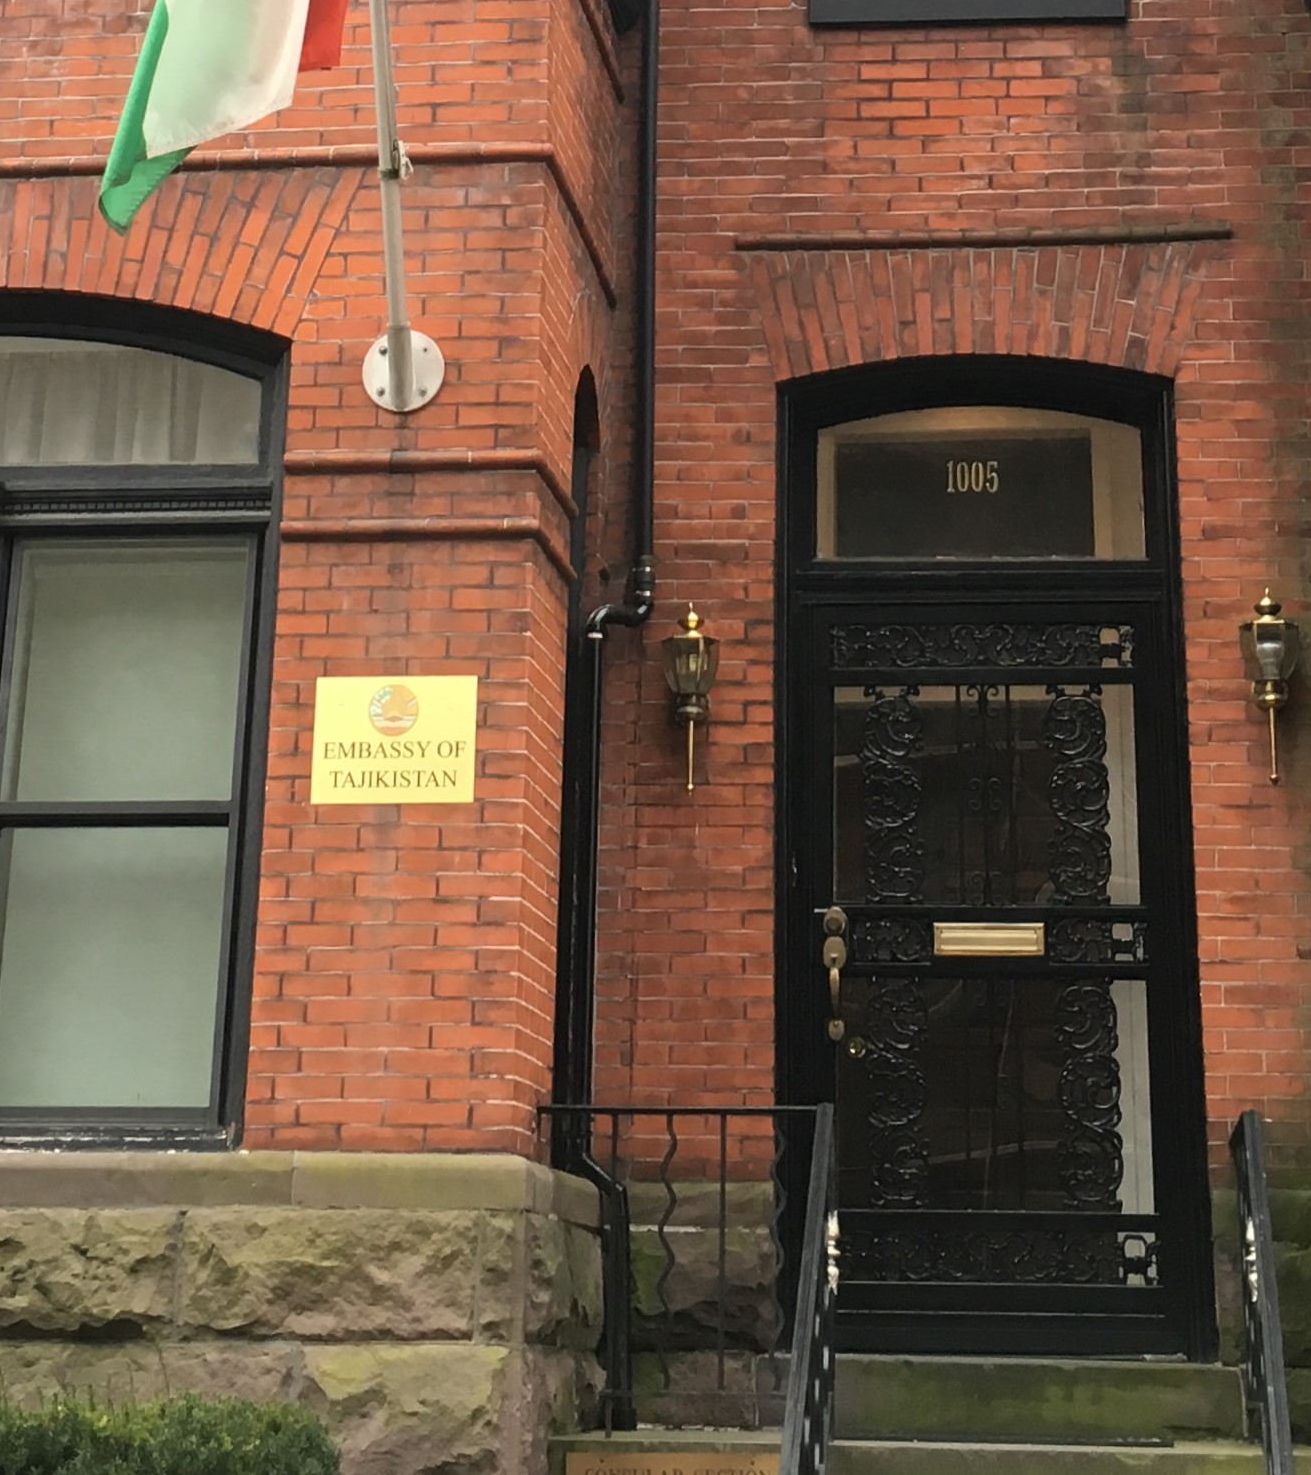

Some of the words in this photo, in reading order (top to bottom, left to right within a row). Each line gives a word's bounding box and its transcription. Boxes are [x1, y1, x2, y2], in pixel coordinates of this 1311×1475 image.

[946, 460, 999, 493] 1005
[323, 740, 432, 759] EMBASSY
[437, 740, 467, 758] OF
[329, 769, 457, 788] TAJIKISTAN
